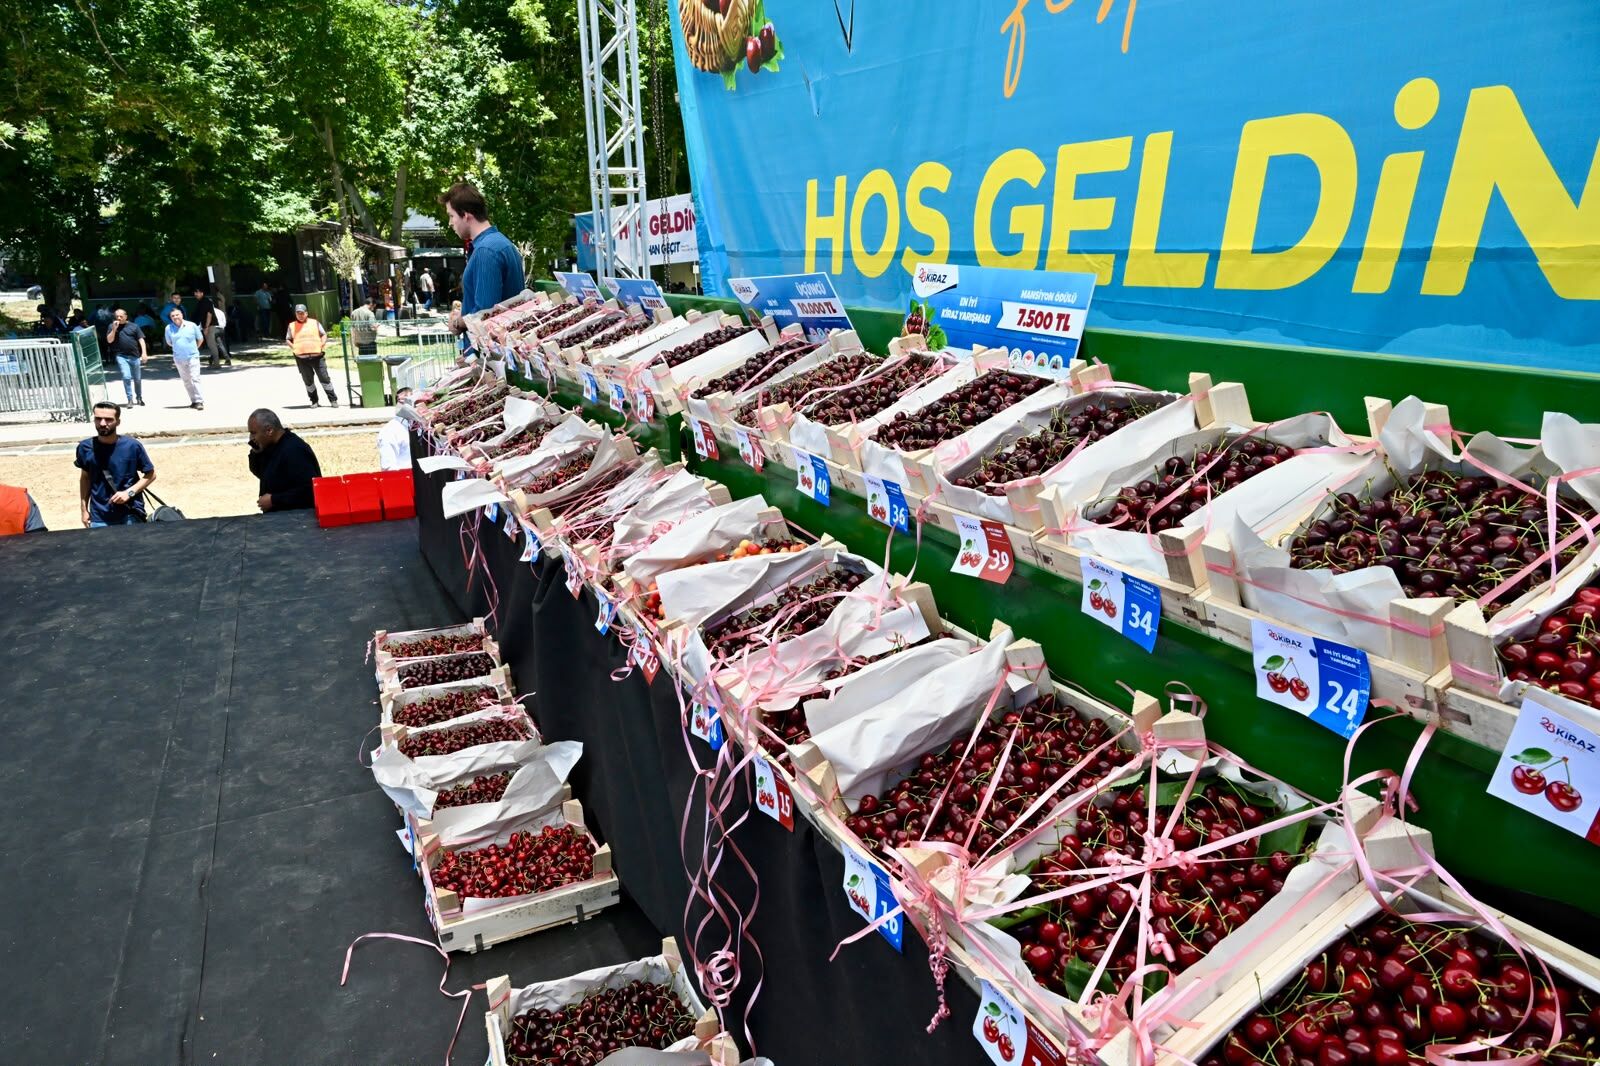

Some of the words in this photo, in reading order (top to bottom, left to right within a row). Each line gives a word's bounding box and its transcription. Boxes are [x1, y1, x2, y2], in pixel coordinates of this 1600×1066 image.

[794, 280, 828, 299] ÜÇÜNCÜ
[1020, 288, 1055, 302] MANSİYON
[1054, 290, 1078, 305] ÖDÜLÜ
[797, 301, 825, 315] 10.000
[824, 301, 838, 314] TL
[1016, 308, 1054, 330] 7.500
[1055, 312, 1071, 332] TL
[816, 477, 828, 497] 40
[892, 504, 906, 526] 36
[988, 549, 1010, 572] 39
[1128, 603, 1153, 636] 34
[1326, 680, 1359, 721] 24
[779, 791, 791, 818] 15
